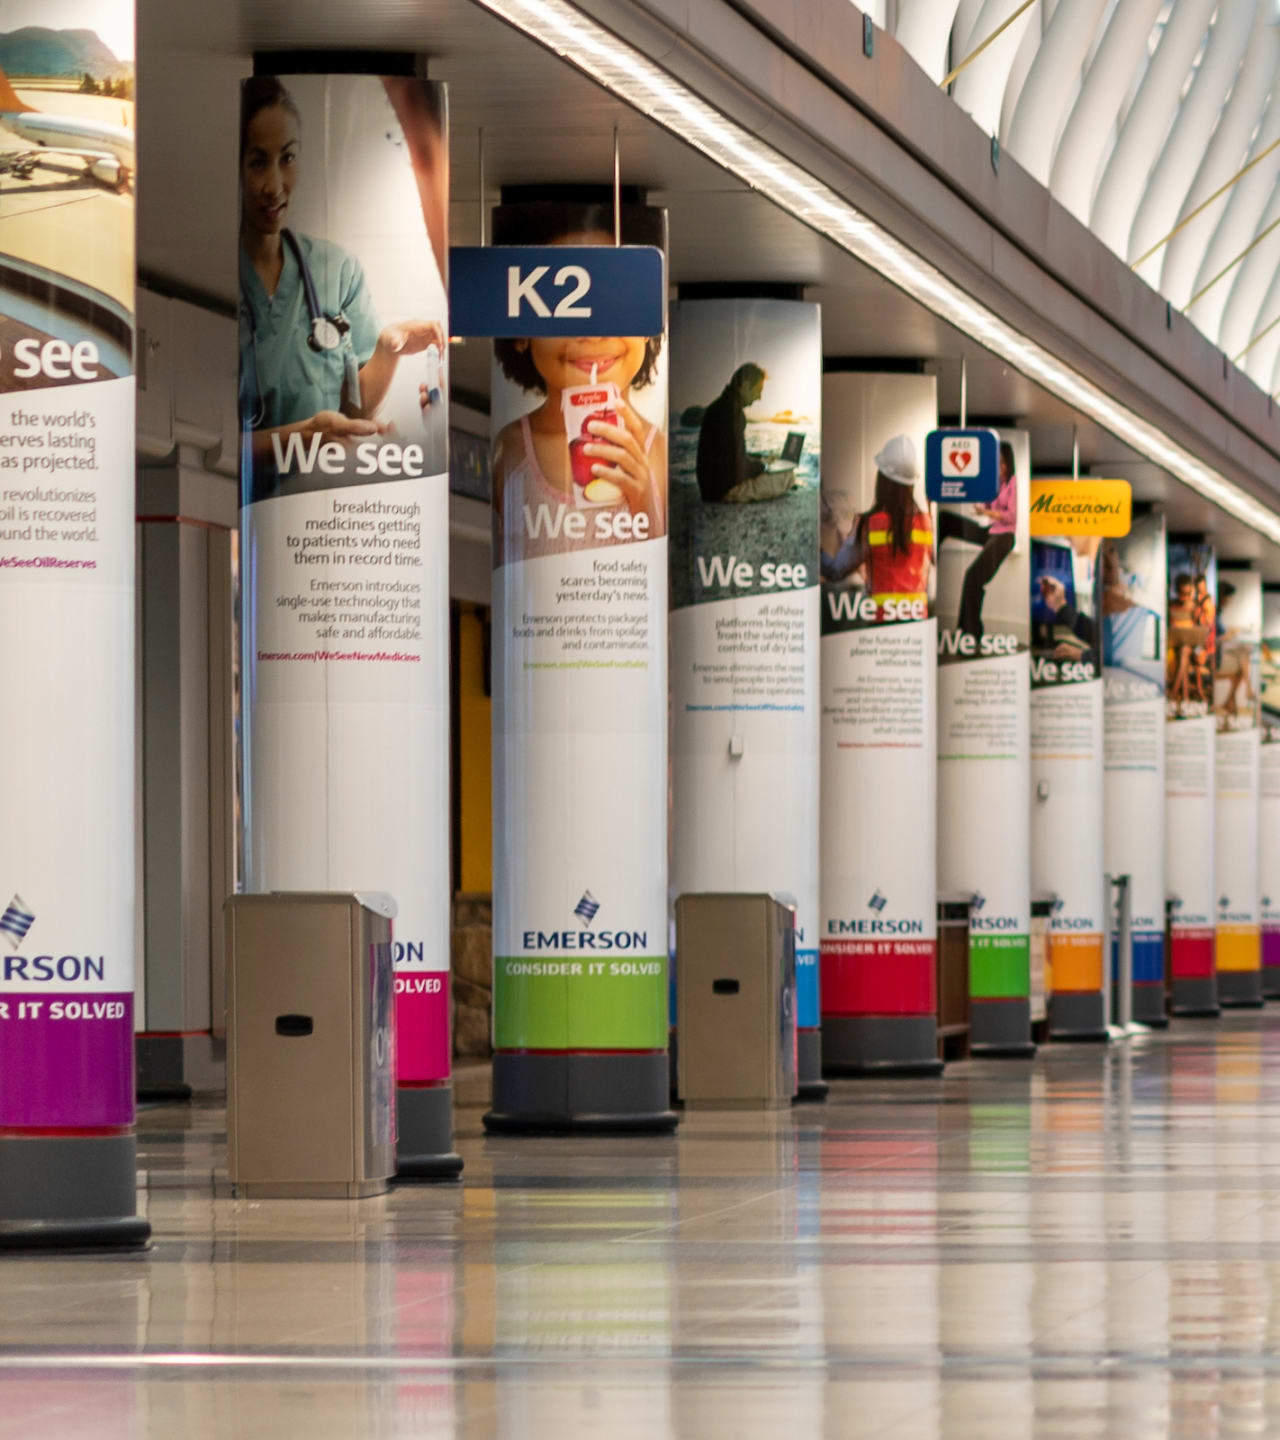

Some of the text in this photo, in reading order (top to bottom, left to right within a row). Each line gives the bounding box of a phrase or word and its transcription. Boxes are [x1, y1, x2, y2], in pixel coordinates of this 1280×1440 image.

[507, 265, 592, 318] K2
[14, 338, 99, 379] see
[11, 410, 95, 427] the world's
[48, 432, 95, 452] lasting
[271, 431, 423, 476] We see
[1, 455, 98, 472] as projected.
[3, 487, 96, 502] revolutionizes
[333, 500, 420, 518] breakthrough
[1031, 494, 1121, 514] Macaroni
[19, 507, 28, 521] is
[33, 508, 96, 522] recovered
[523, 504, 649, 539] We see
[35, 526, 99, 541] the world.
[305, 518, 420, 535] medicines getting
[287, 535, 420, 550] to patients who need
[294, 552, 329, 564] them
[333, 552, 345, 564] in
[349, 552, 391, 565] record
[593, 560, 618, 572] food
[698, 556, 807, 588] We see
[310, 579, 420, 592] Emerson introduces
[561, 577, 595, 586] scares
[276, 594, 420, 610] single-use technology that
[556, 590, 621, 604] yesterday's
[828, 592, 924, 620] We see
[299, 611, 420, 626] makes manufacturing
[316, 626, 365, 638] safe and
[981, 634, 1017, 654] see
[1061, 662, 1094, 681] see
[828, 919, 922, 933] EMERSON
[523, 931, 647, 950] EMERSON
[505, 963, 661, 976] CONSIDER IT SOLVED
[19, 1002, 43, 1019] IT
[49, 1002, 124, 1020] SOLVED
